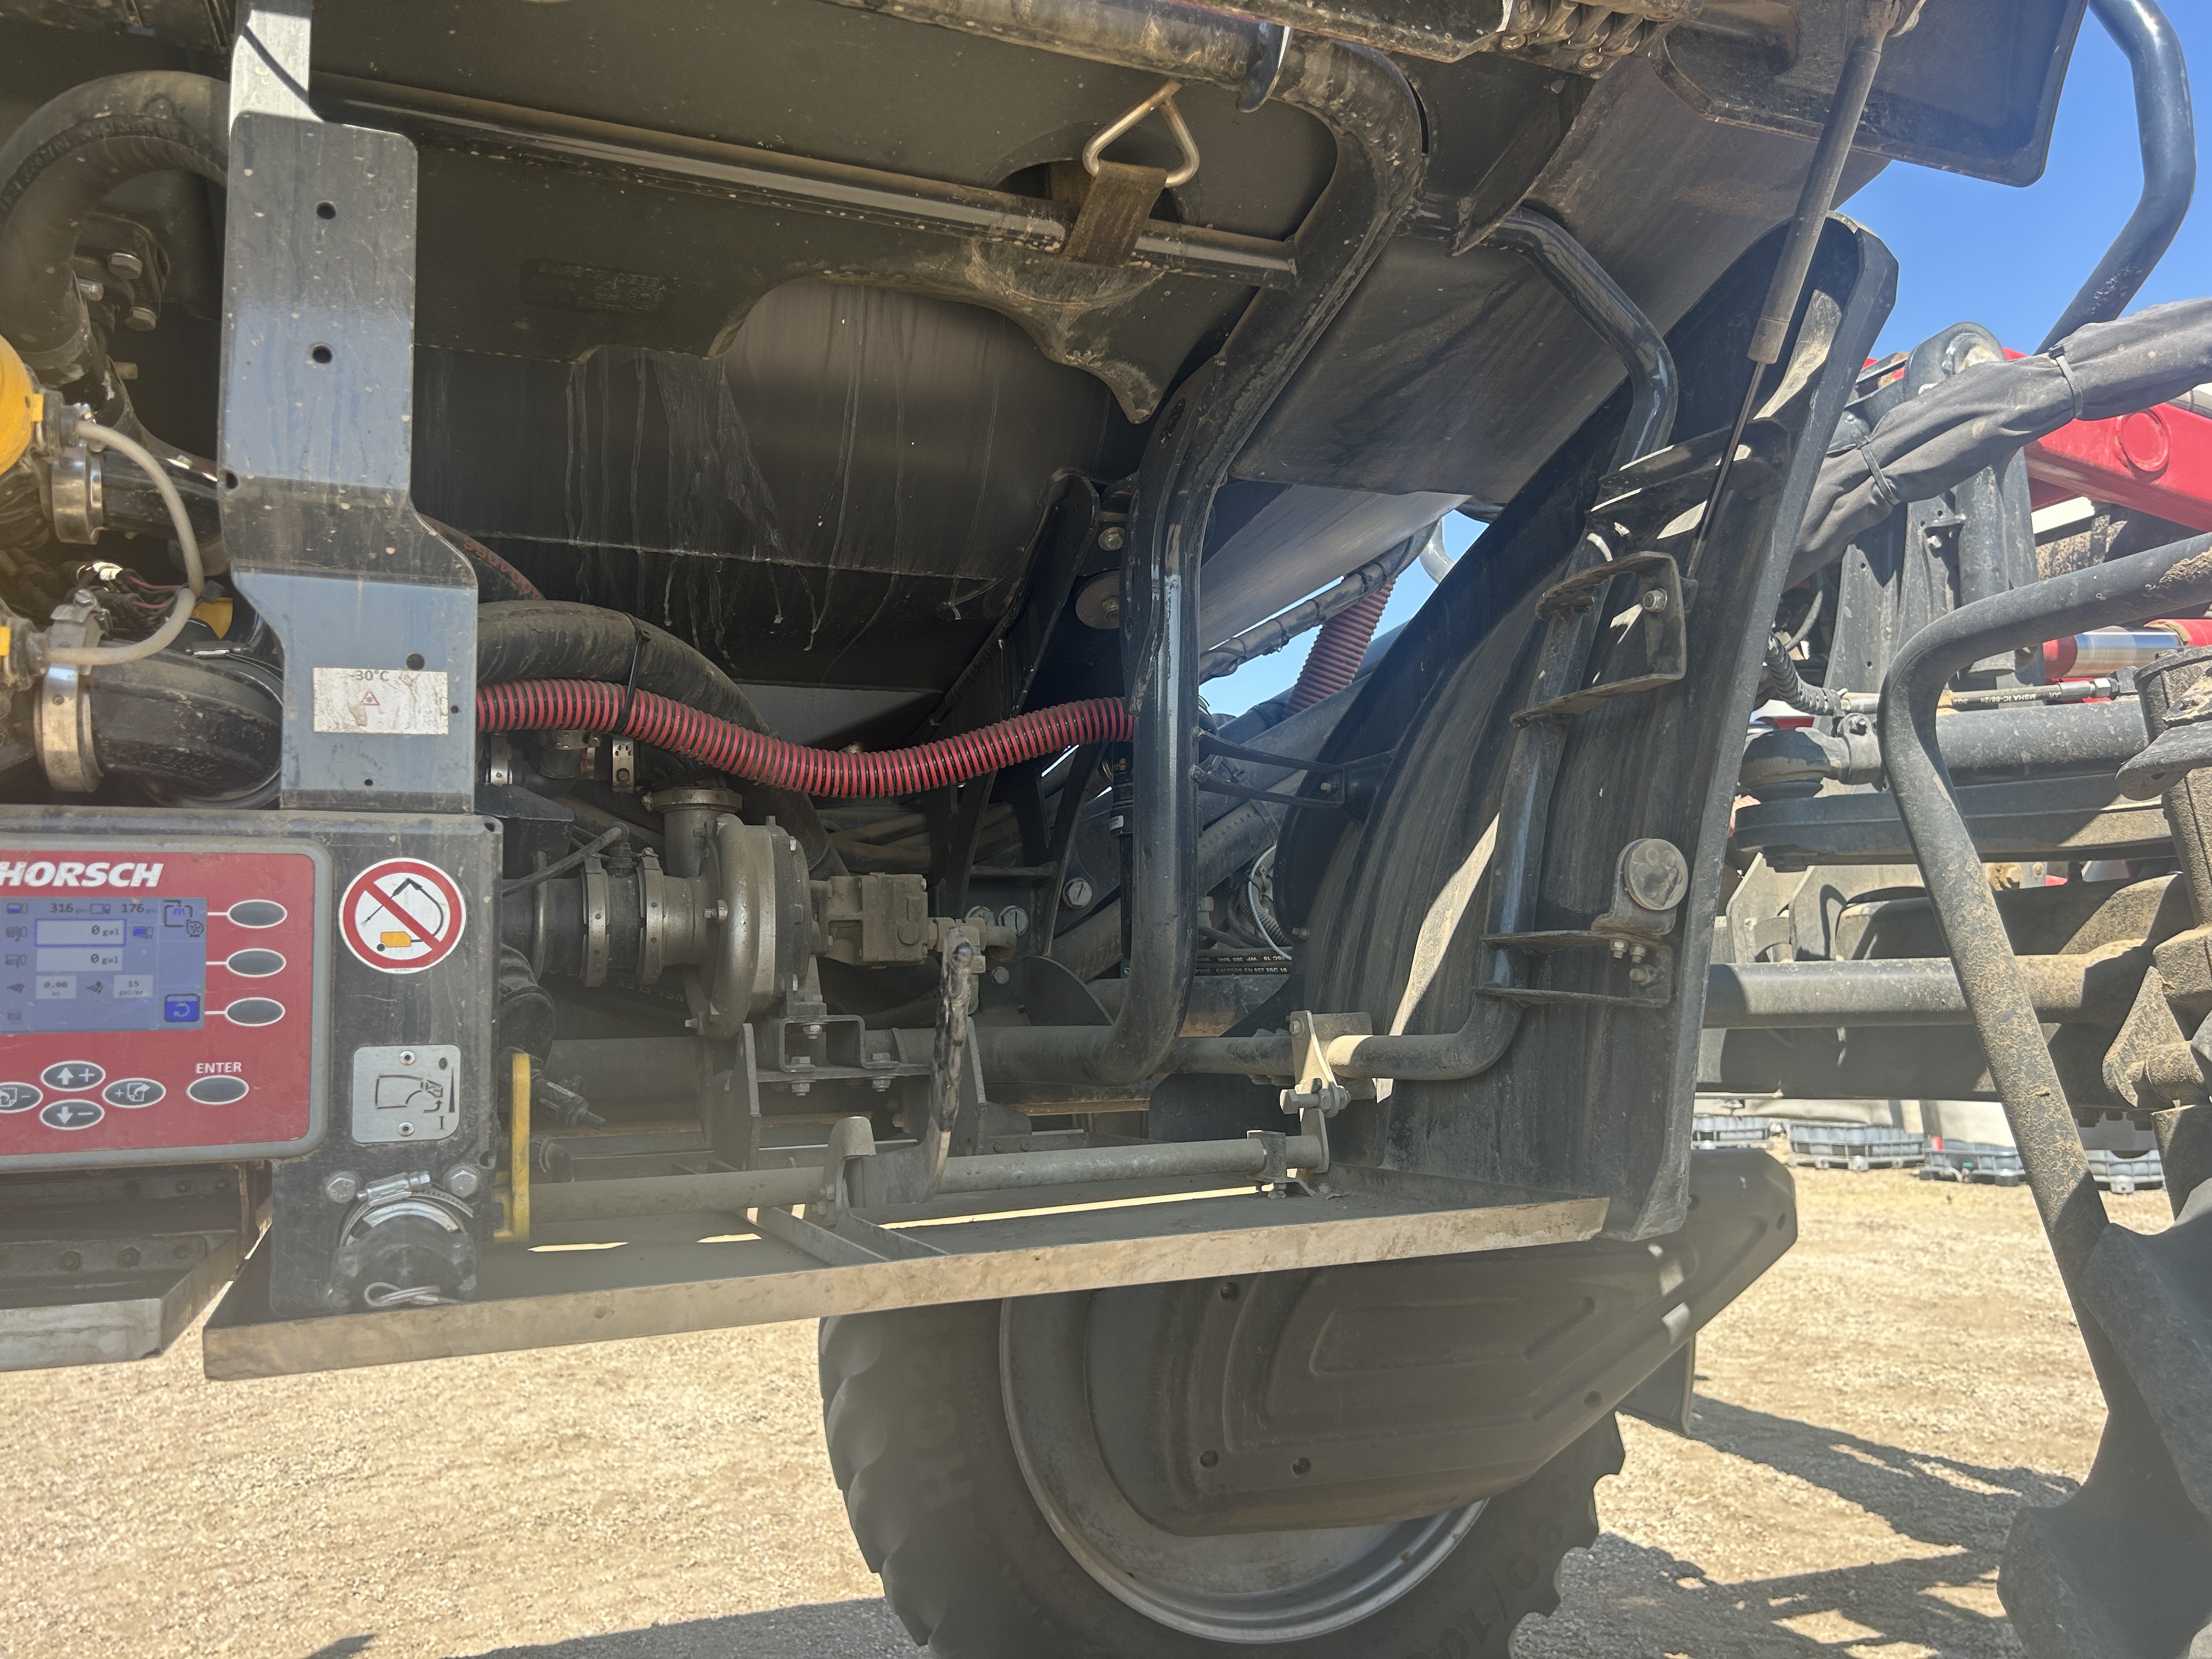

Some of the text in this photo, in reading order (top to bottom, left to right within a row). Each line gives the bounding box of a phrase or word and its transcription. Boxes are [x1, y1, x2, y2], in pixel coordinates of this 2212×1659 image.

[0, 861, 163, 887] HORSCH
[50, 903, 74, 913] 316
[121, 903, 144, 913] 176
[92, 925, 119, 936] 0 gal
[91, 953, 119, 964] 0 gal
[196, 1062, 242, 1074] ENTER
